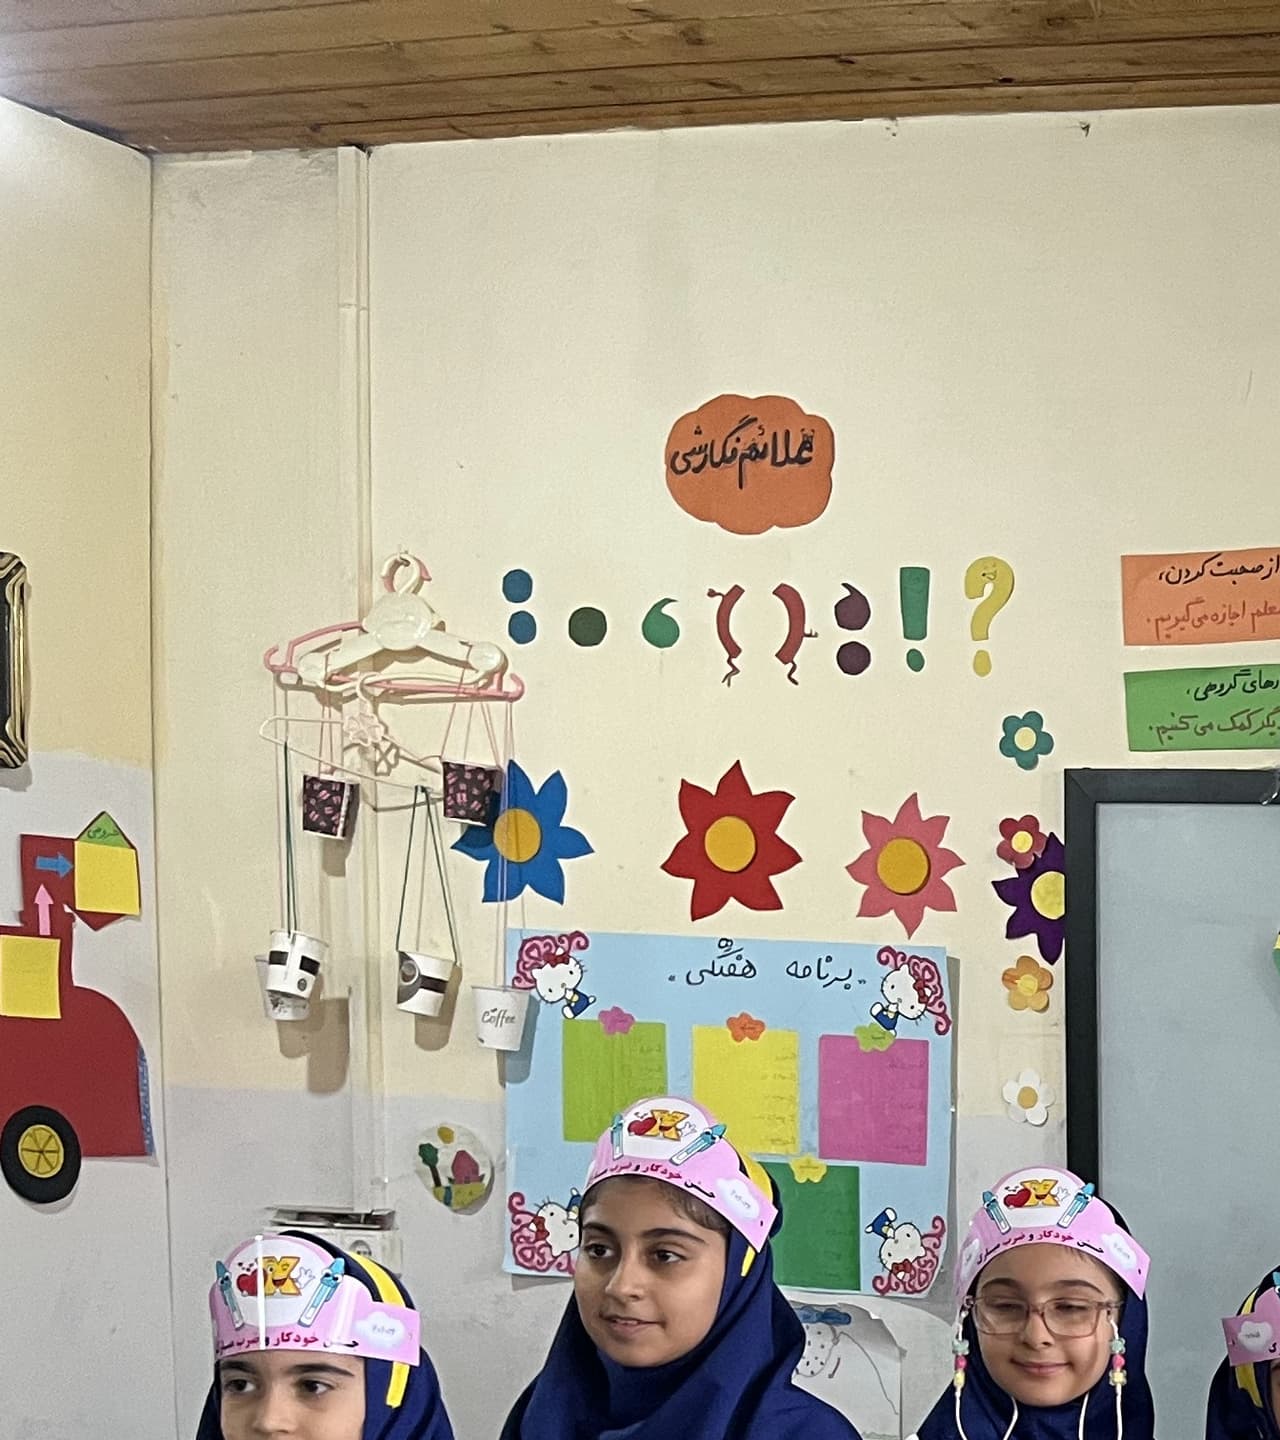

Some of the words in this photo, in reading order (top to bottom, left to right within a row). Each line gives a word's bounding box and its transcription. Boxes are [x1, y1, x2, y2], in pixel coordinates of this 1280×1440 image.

[670, 415, 758, 475] نگارشی
[1210, 560, 1263, 584] صحبت
[1261, 555, 1280, 580] از
[1192, 613, 1210, 628] می
[1211, 600, 1245, 626] اجازه
[1194, 719, 1215, 736] می
[1217, 708, 1265, 733] کمک
[685, 938, 757, 985] هفتگی
[481, 1007, 516, 1027] Coffee
[643, 1163, 682, 1180] خودکار
[1029, 1233, 1034, 1242] و
[1037, 1230, 1074, 1243] خودکار
[273, 1331, 319, 1347] خودکار
